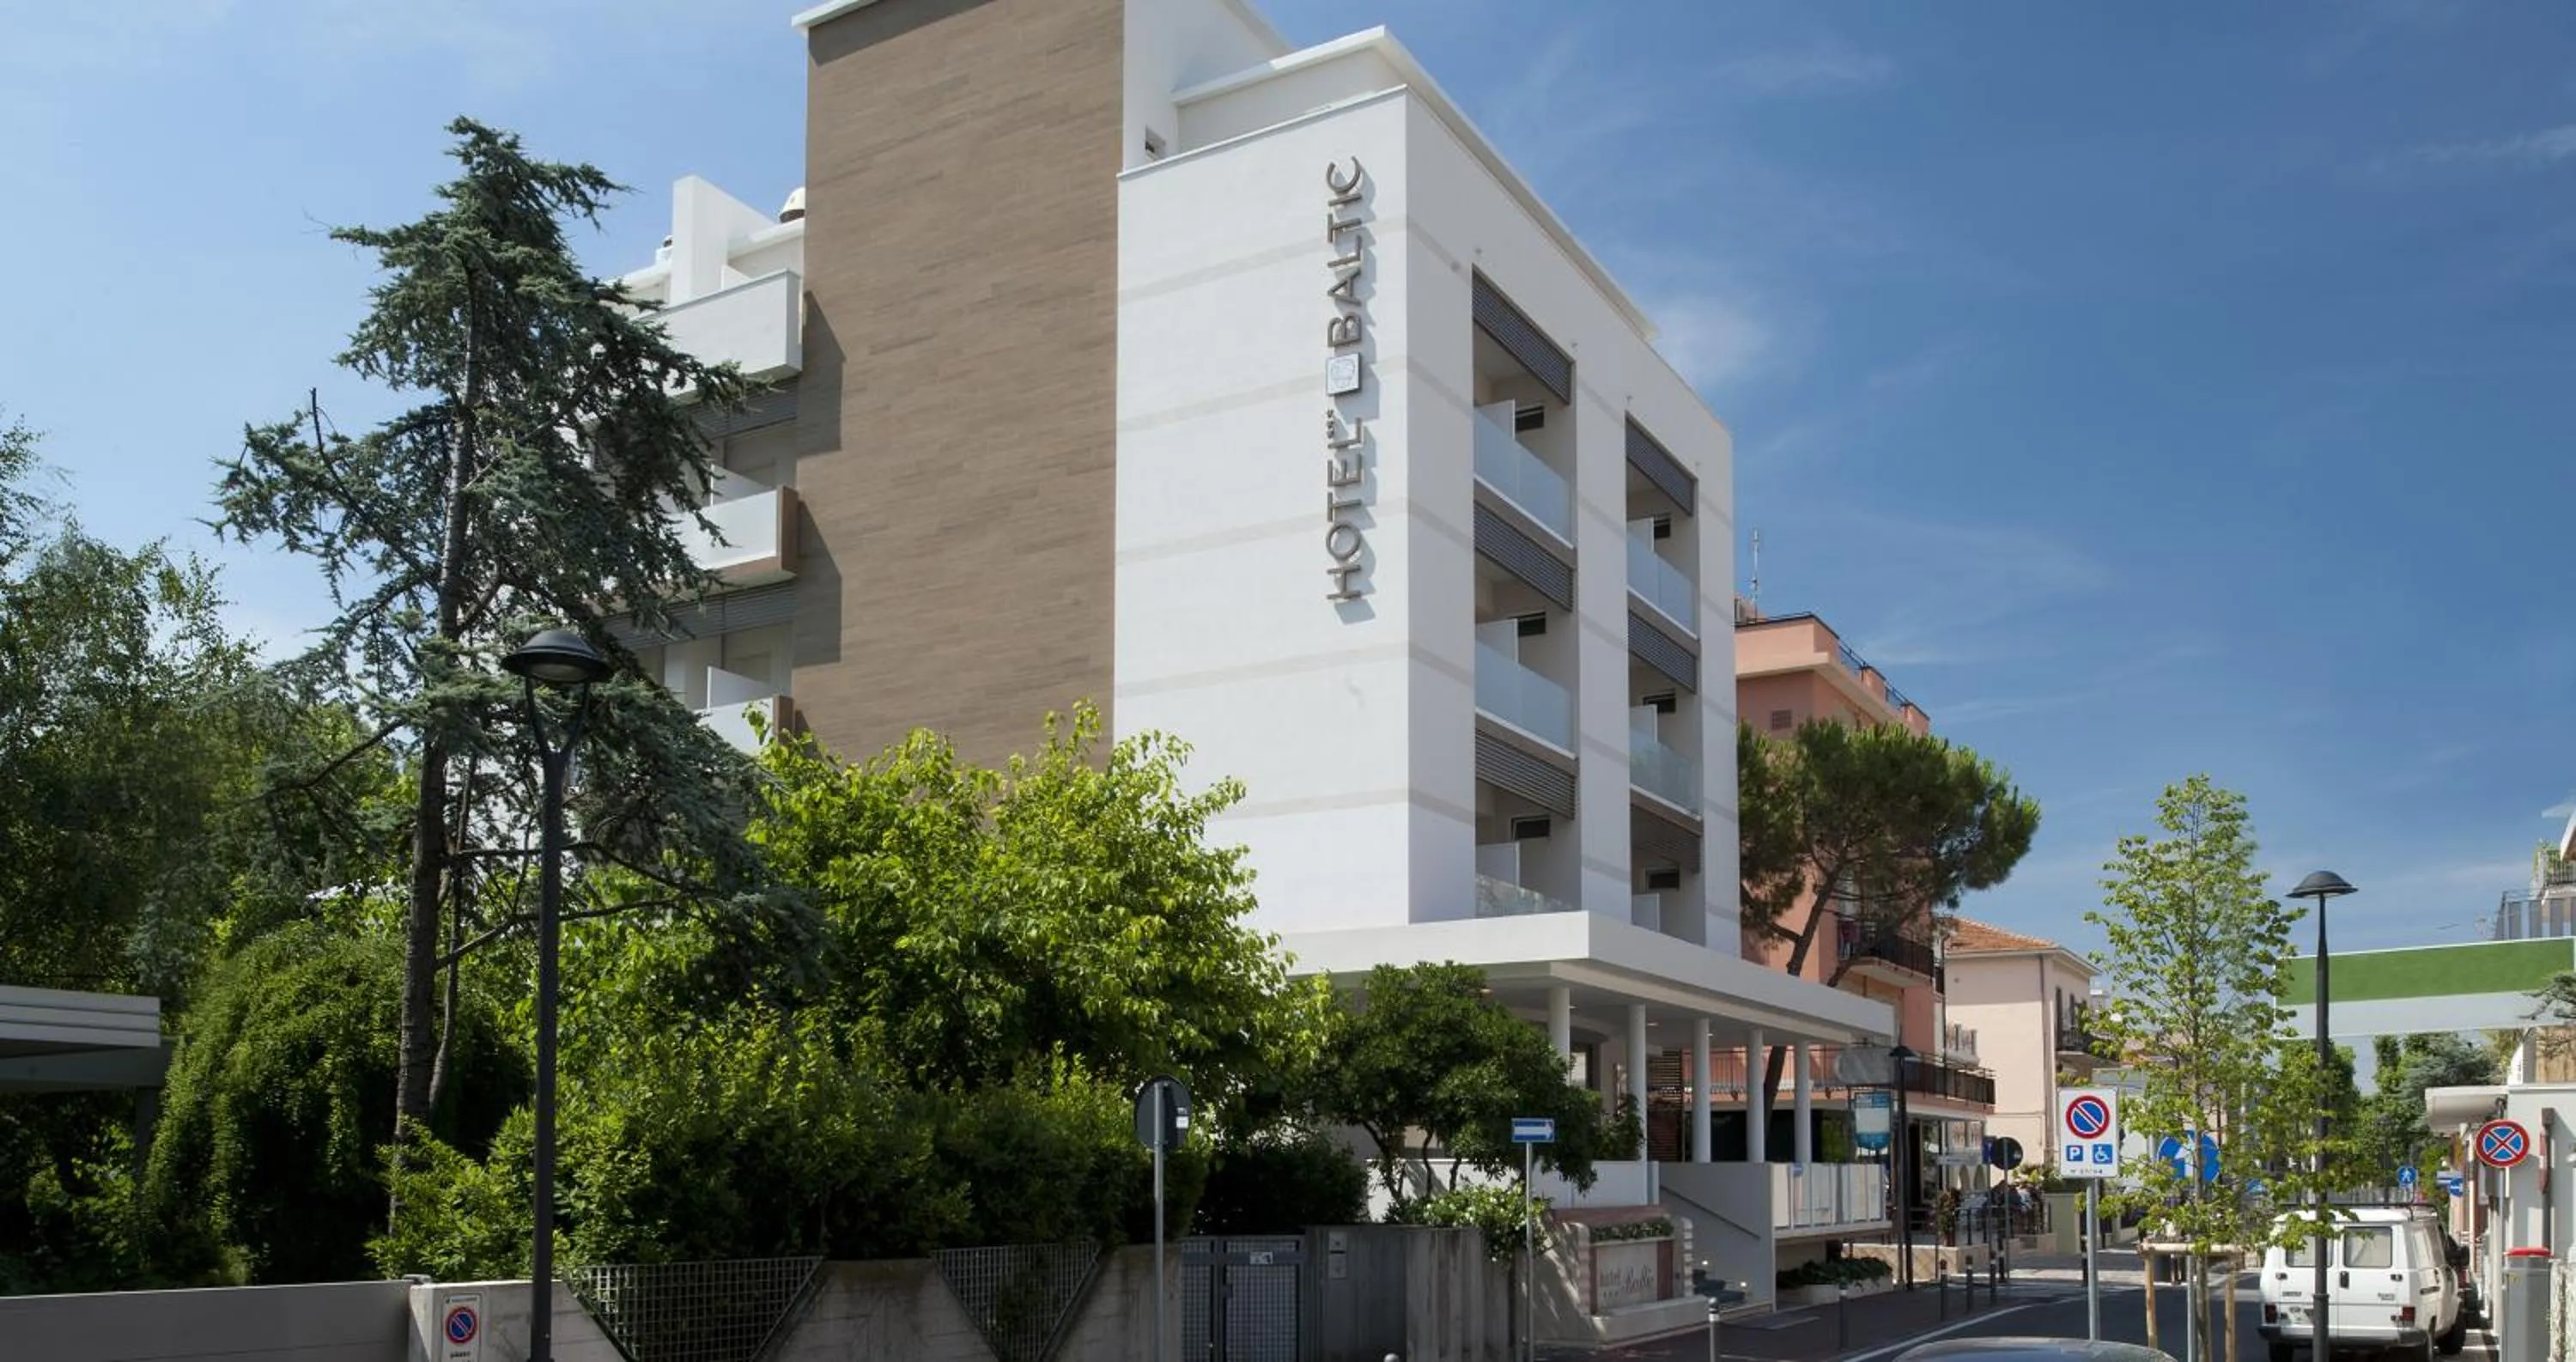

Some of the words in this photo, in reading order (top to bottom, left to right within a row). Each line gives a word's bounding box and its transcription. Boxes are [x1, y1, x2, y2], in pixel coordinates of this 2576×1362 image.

[1326, 155, 1363, 349] BALTIC
[1326, 417, 1363, 600] HOTEL
[2069, 1146, 2081, 1159] P
